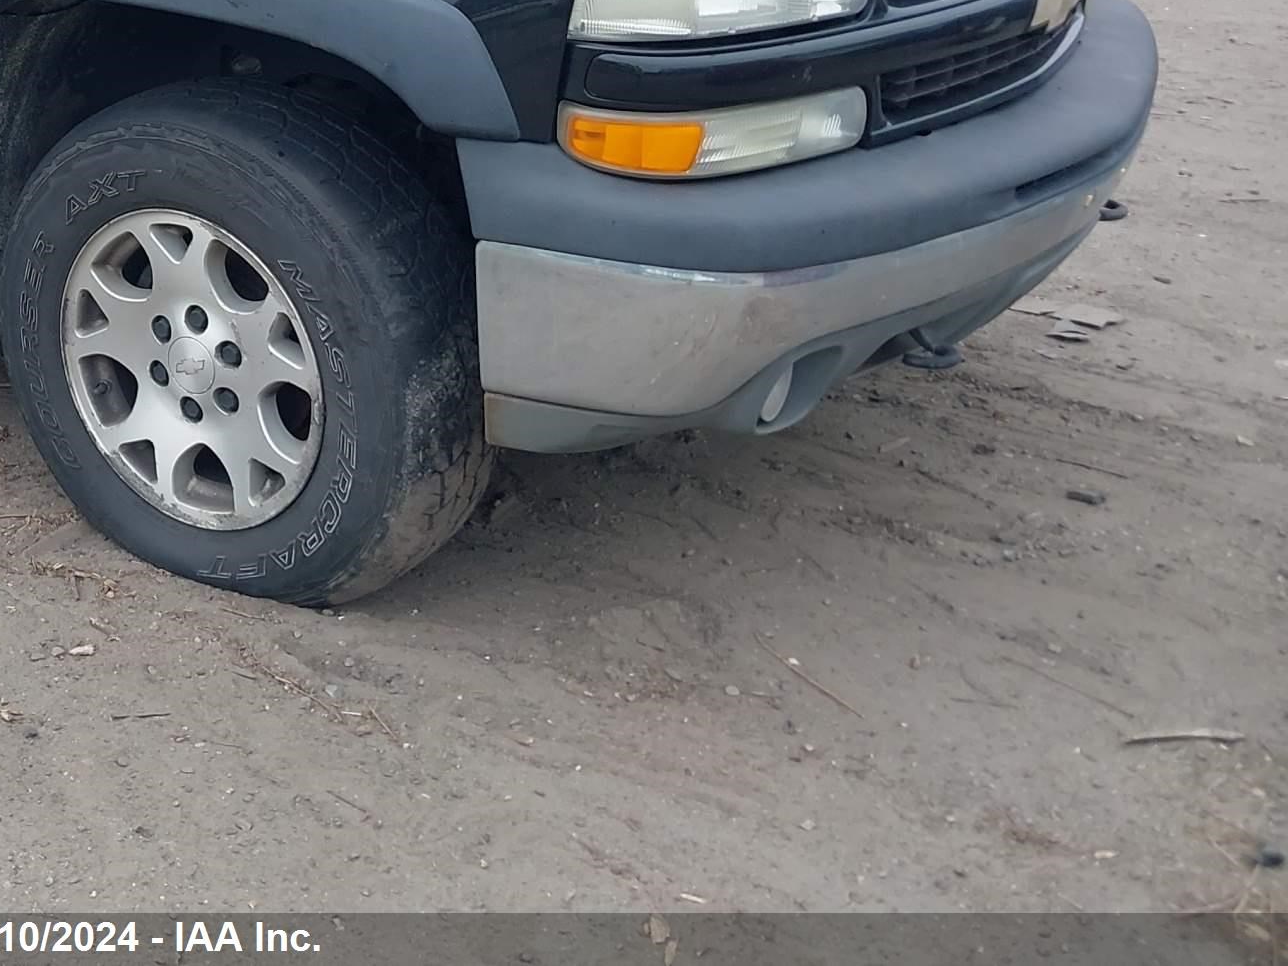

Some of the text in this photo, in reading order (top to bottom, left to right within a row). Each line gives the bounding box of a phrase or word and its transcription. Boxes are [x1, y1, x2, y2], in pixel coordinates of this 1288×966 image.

[19, 169, 146, 470] COURSER AXT
[198, 258, 360, 580] MASTERCRAFT
